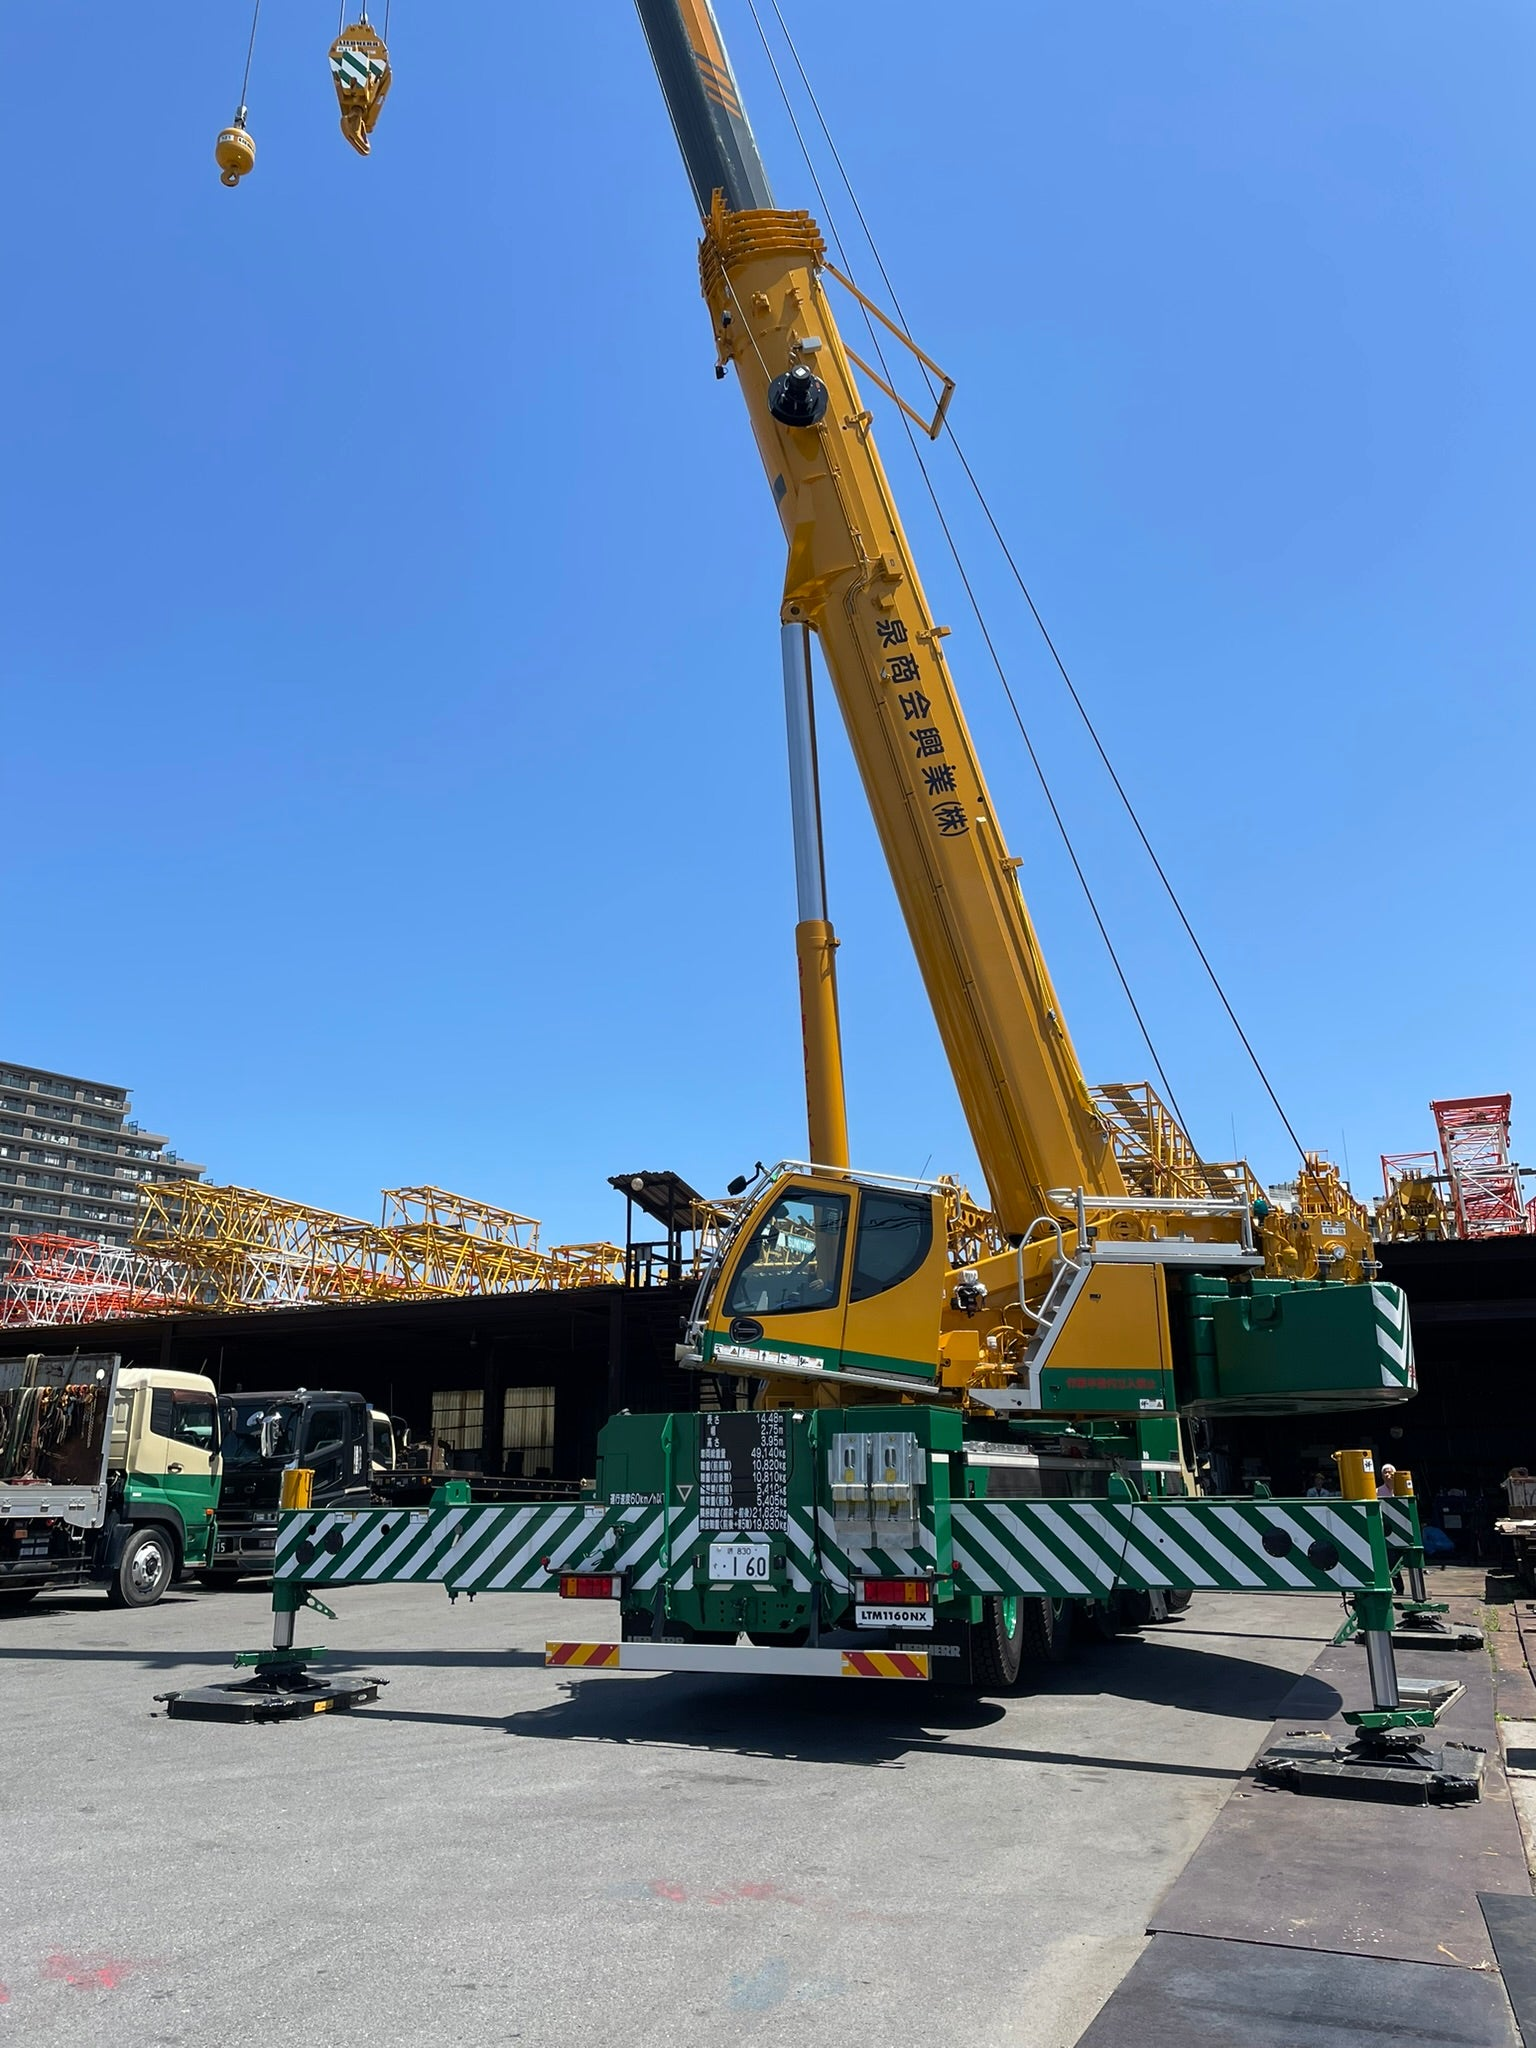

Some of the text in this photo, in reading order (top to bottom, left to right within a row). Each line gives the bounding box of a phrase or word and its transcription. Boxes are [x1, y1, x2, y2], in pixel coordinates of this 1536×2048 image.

[755, 1412, 784, 1424] 14.48m
[760, 1424, 784, 1436] 2.75m
[760, 1436, 784, 1447] 3.95m
[750, 1447, 786, 1459] 49,140kg
[752, 1459, 787, 1471] 10,820kg
[752, 1471, 787, 1483] 10,810kg
[756, 1495, 787, 1507] 5,405kg
[752, 1506, 787, 1519] 21,625kg
[753, 1518, 787, 1531] 19,830kg
[737, 1547, 751, 1555] 830
[861, 1611, 927, 1621] LTM1160NX
